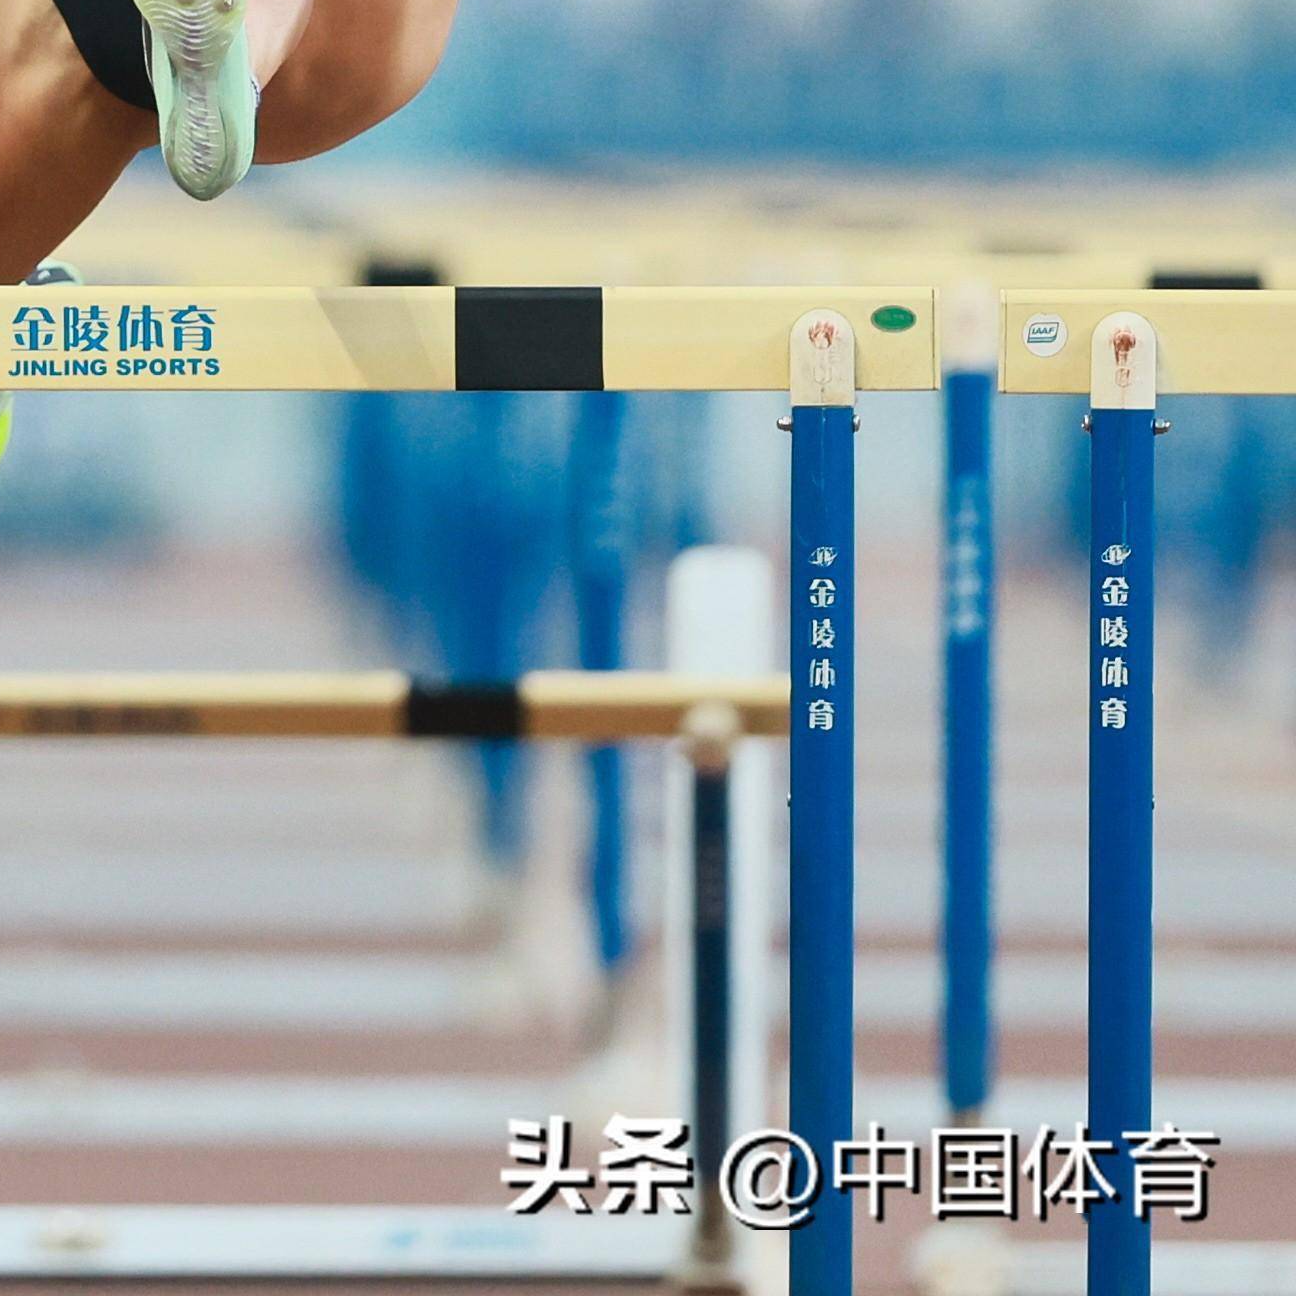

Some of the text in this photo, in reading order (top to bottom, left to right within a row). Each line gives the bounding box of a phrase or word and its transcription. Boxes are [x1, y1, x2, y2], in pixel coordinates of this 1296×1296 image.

[8, 358, 220, 377] JINLING SPORTS
[10, 304, 218, 352] 金陵体育
[807, 578, 837, 731] 金陵体育
[1100, 576, 1130, 730] 金陵体育
